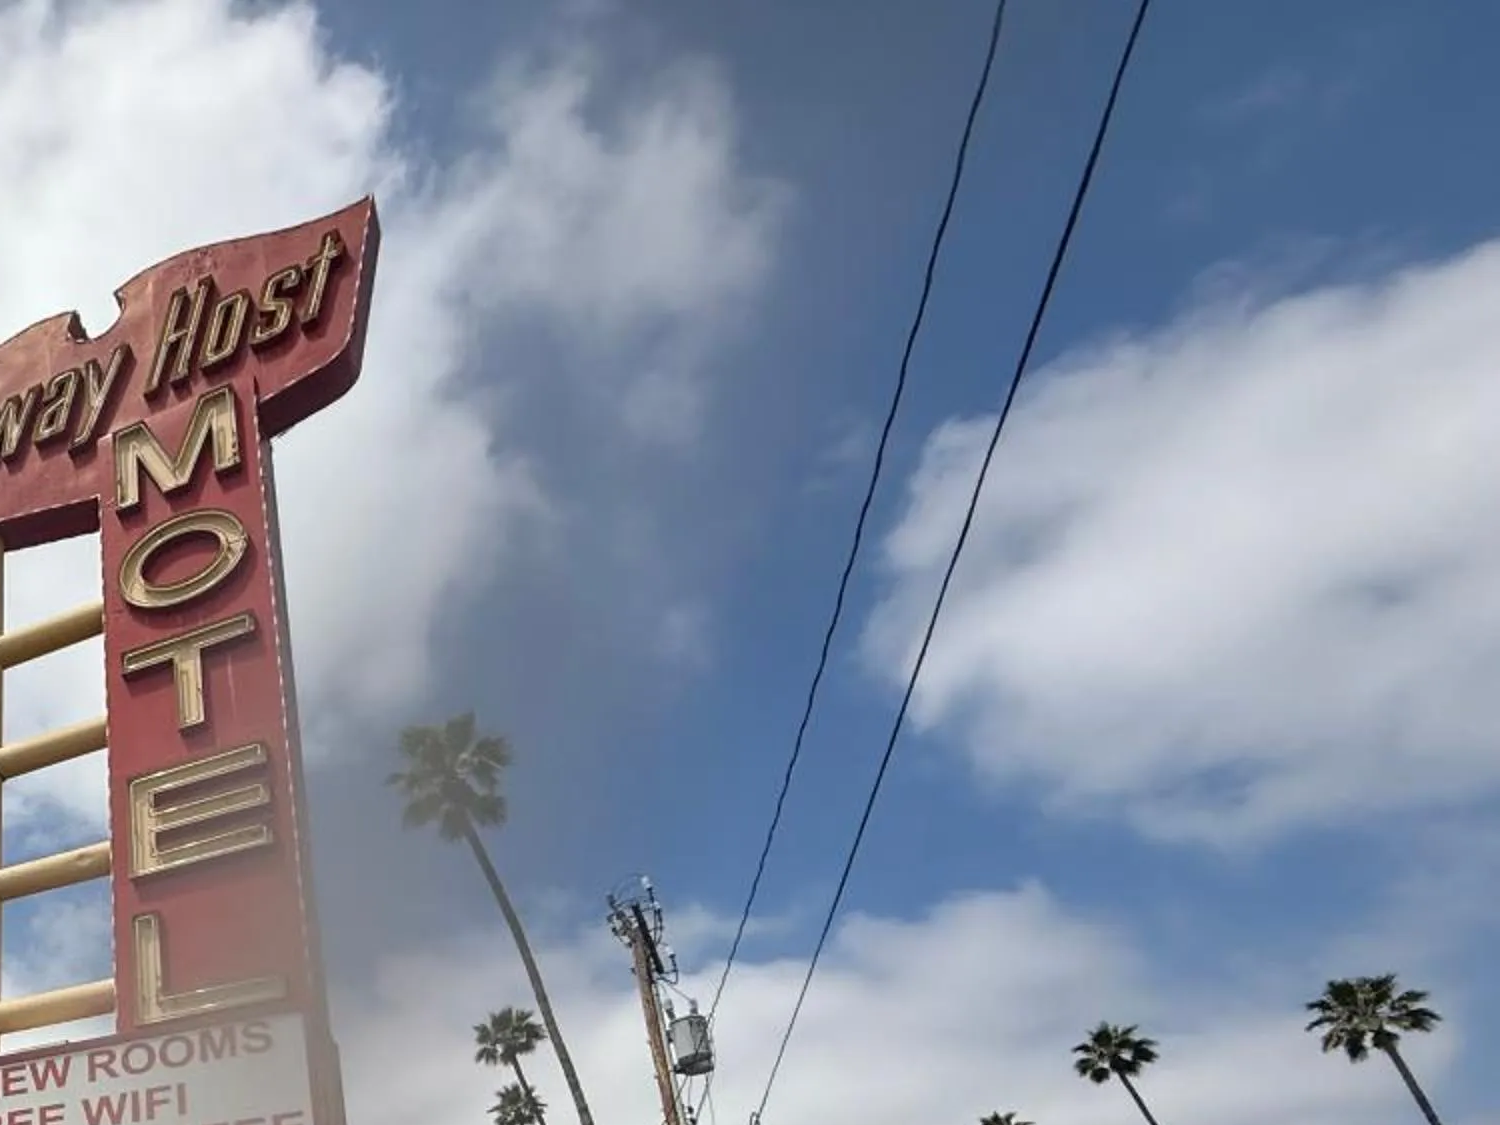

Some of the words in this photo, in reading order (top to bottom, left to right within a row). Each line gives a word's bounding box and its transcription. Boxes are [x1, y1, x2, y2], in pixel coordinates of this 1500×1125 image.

[144, 228, 343, 400] Host
[117, 386, 288, 1026] MOTEL
[87, 1020, 272, 1083] ROOMS
